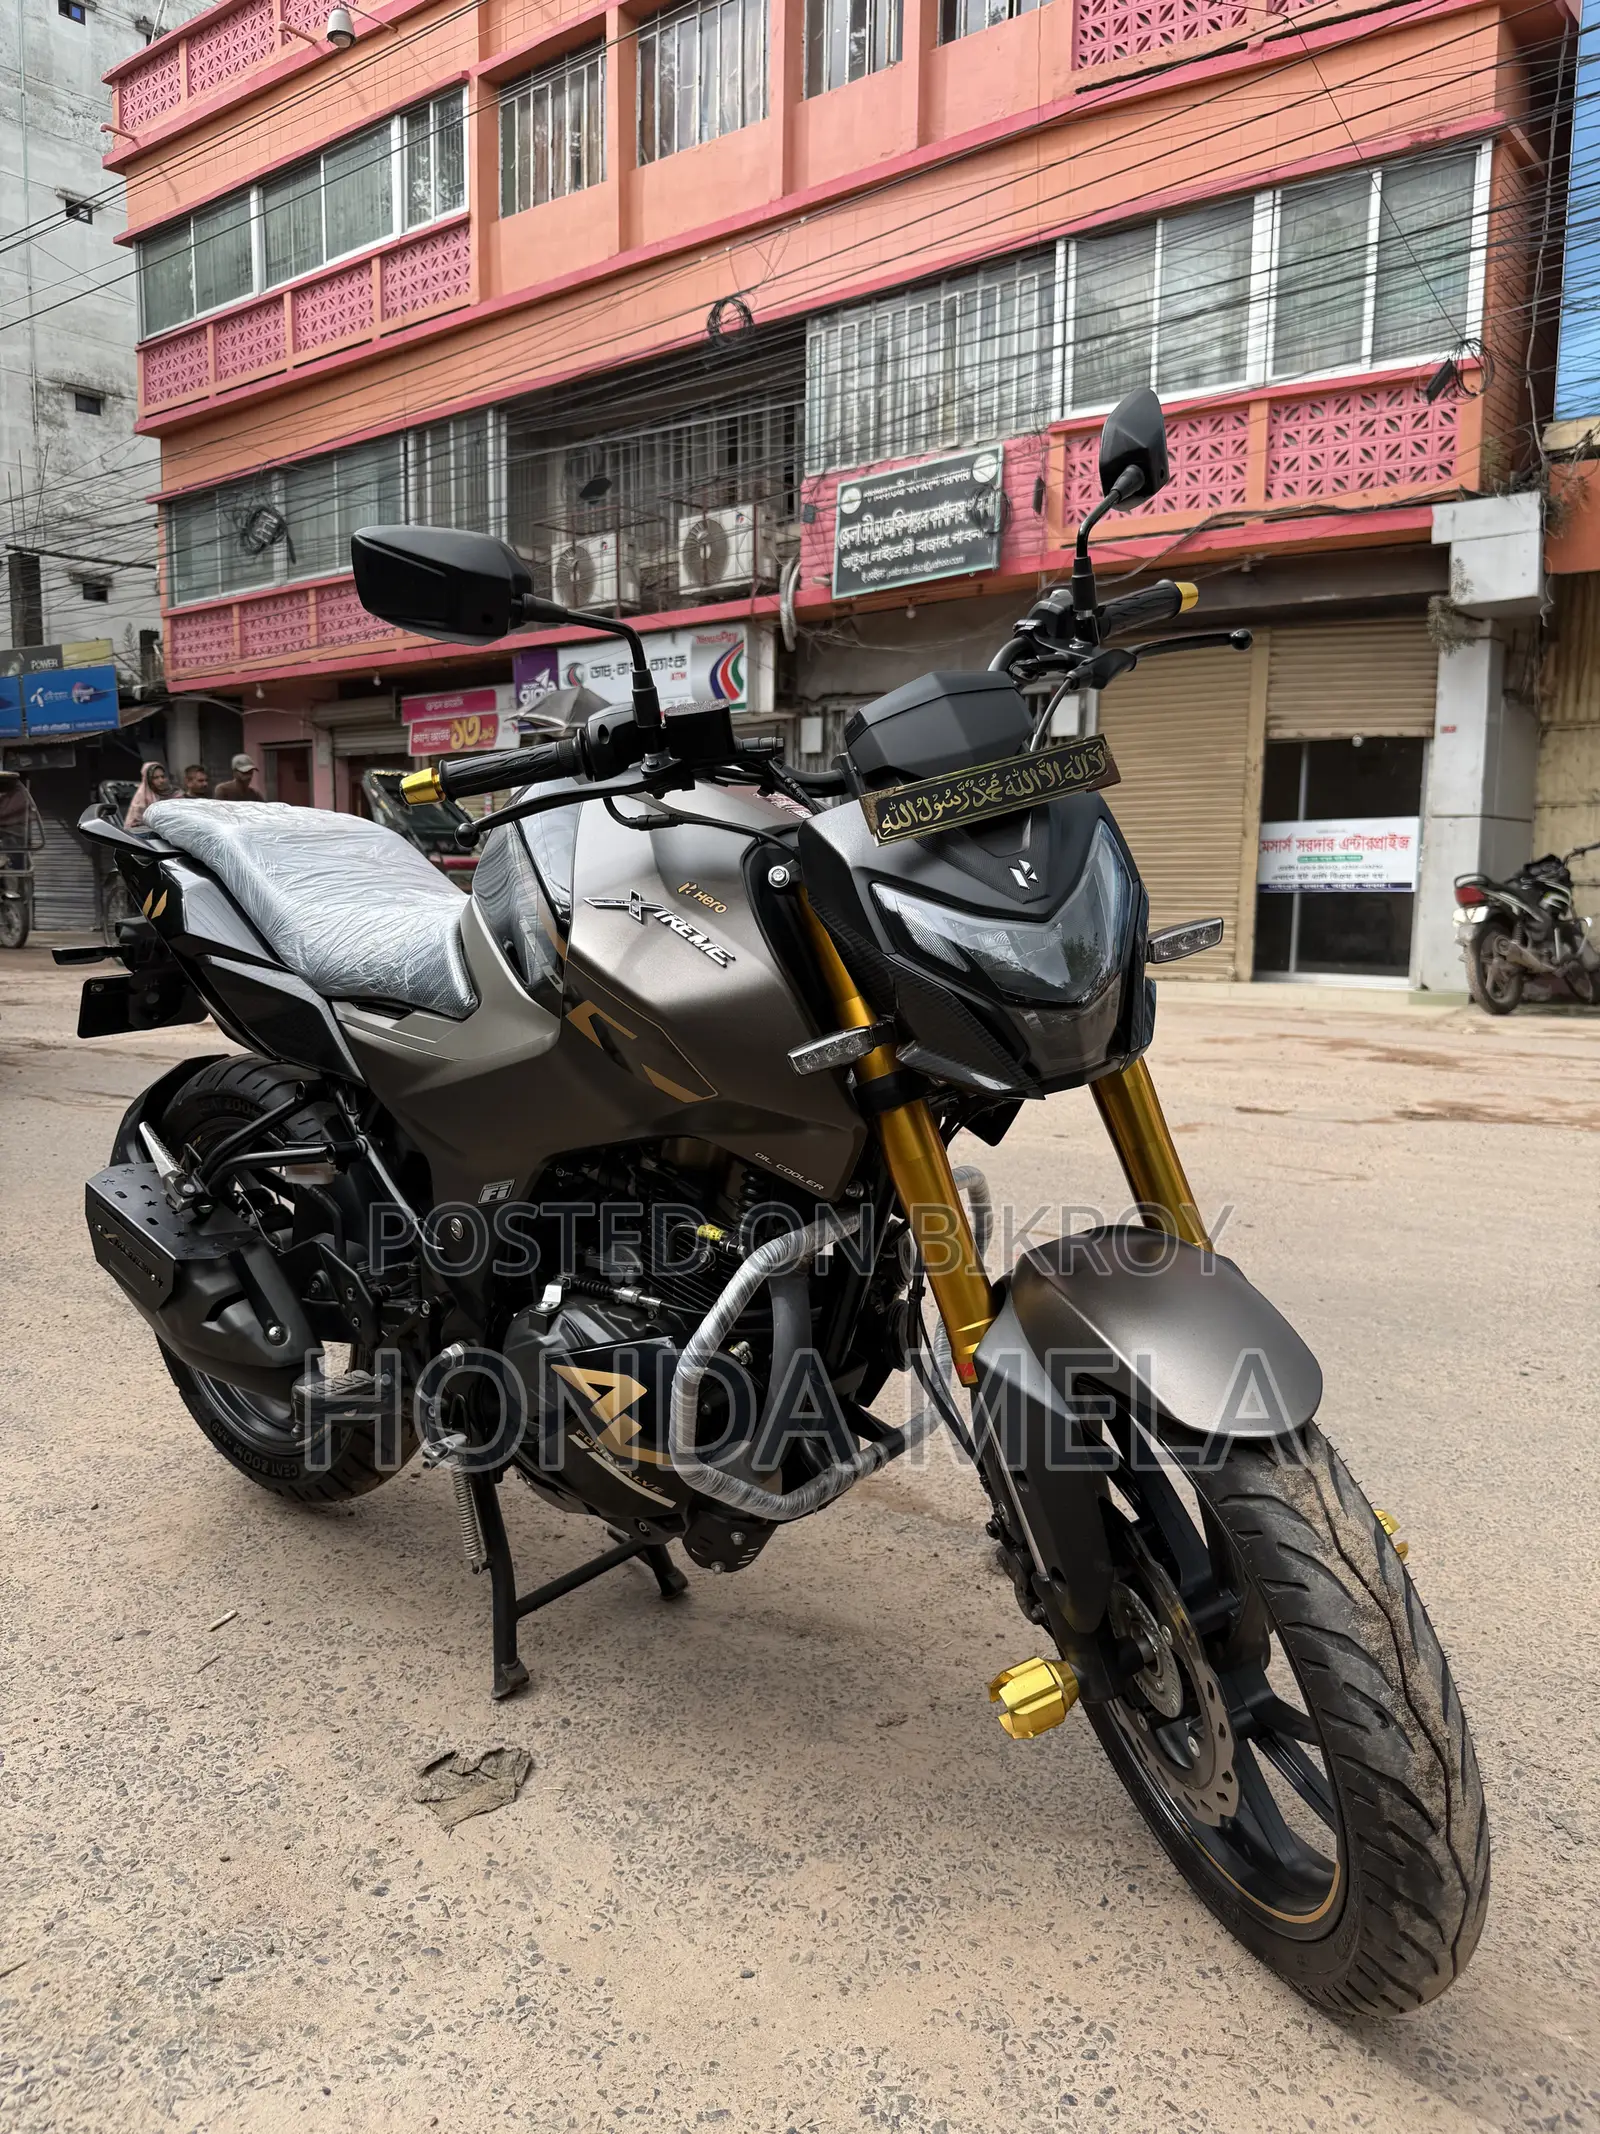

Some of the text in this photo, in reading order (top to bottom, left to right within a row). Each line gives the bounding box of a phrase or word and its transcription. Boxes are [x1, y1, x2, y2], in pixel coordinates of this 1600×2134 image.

[31, 659, 58, 669] POWER
[1295, 837, 1336, 853] সরদার
[1338, 833, 1411, 852] এন্টারপ্রাইজ
[582, 889, 736, 968] XTREME
[755, 1151, 825, 1192] OIL COOLER
[233, 1443, 269, 1473] ZOOM
[272, 1463, 298, 1477] CEAT
[576, 1429, 665, 1494] FOUR VALVE
